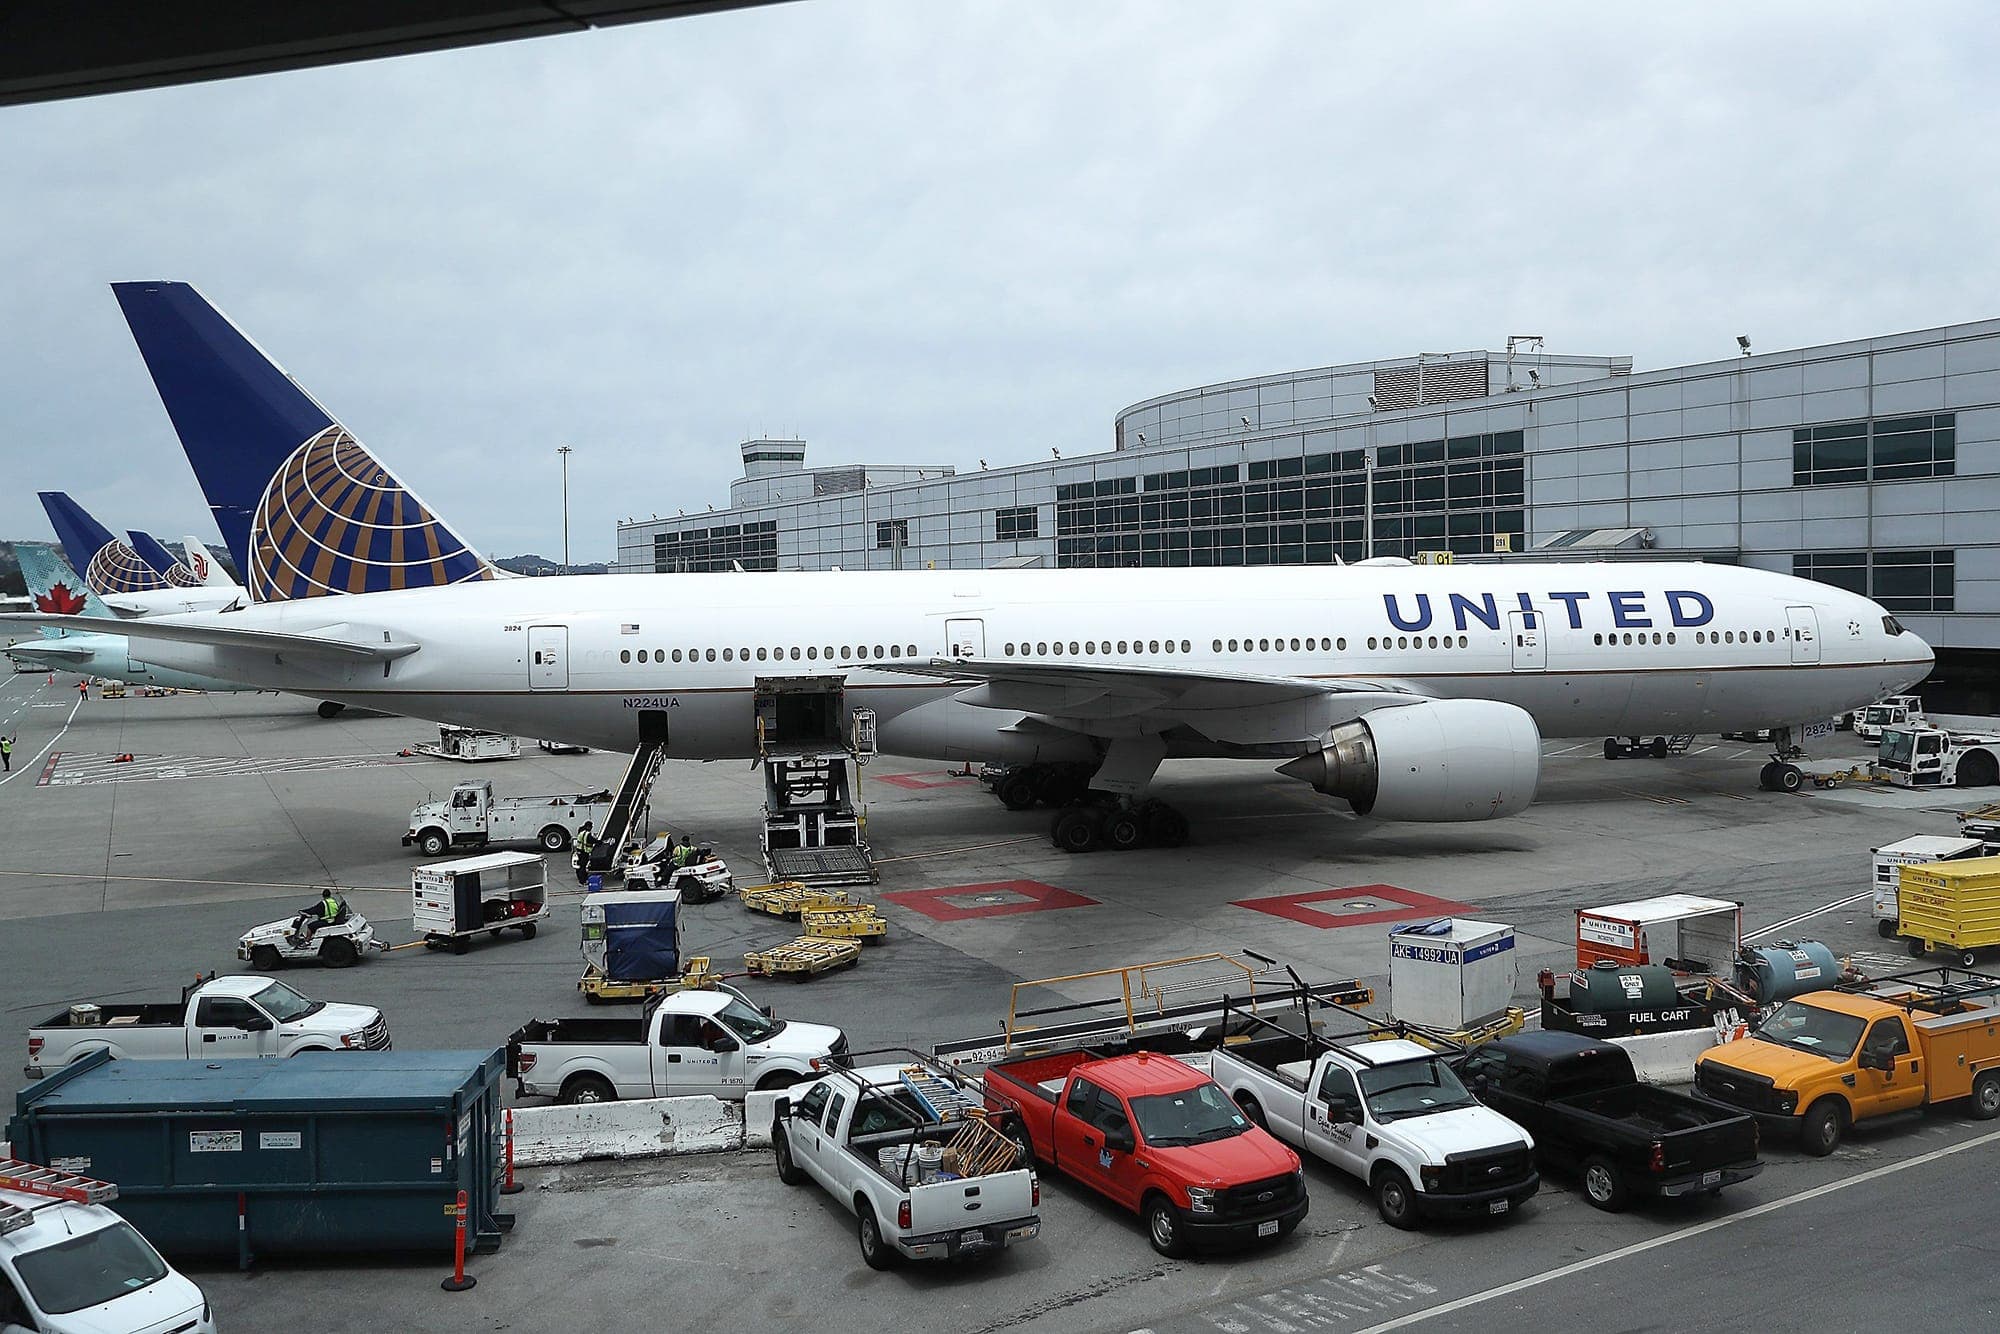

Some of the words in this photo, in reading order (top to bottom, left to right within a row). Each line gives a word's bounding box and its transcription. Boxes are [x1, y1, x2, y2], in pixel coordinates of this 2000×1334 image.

[1383, 590, 1714, 632] UNITED
[623, 698, 680, 708] N224UA
[1805, 723, 1833, 736] 2824
[1912, 875, 1938, 884] UNITED
[1588, 920, 1617, 931] UNITED
[1393, 943, 1411, 958] AKE
[1414, 948, 1441, 962] 14992
[1444, 951, 1458, 964] UA
[1629, 1012, 1657, 1023] FUEL
[1661, 1010, 1691, 1021] CART
